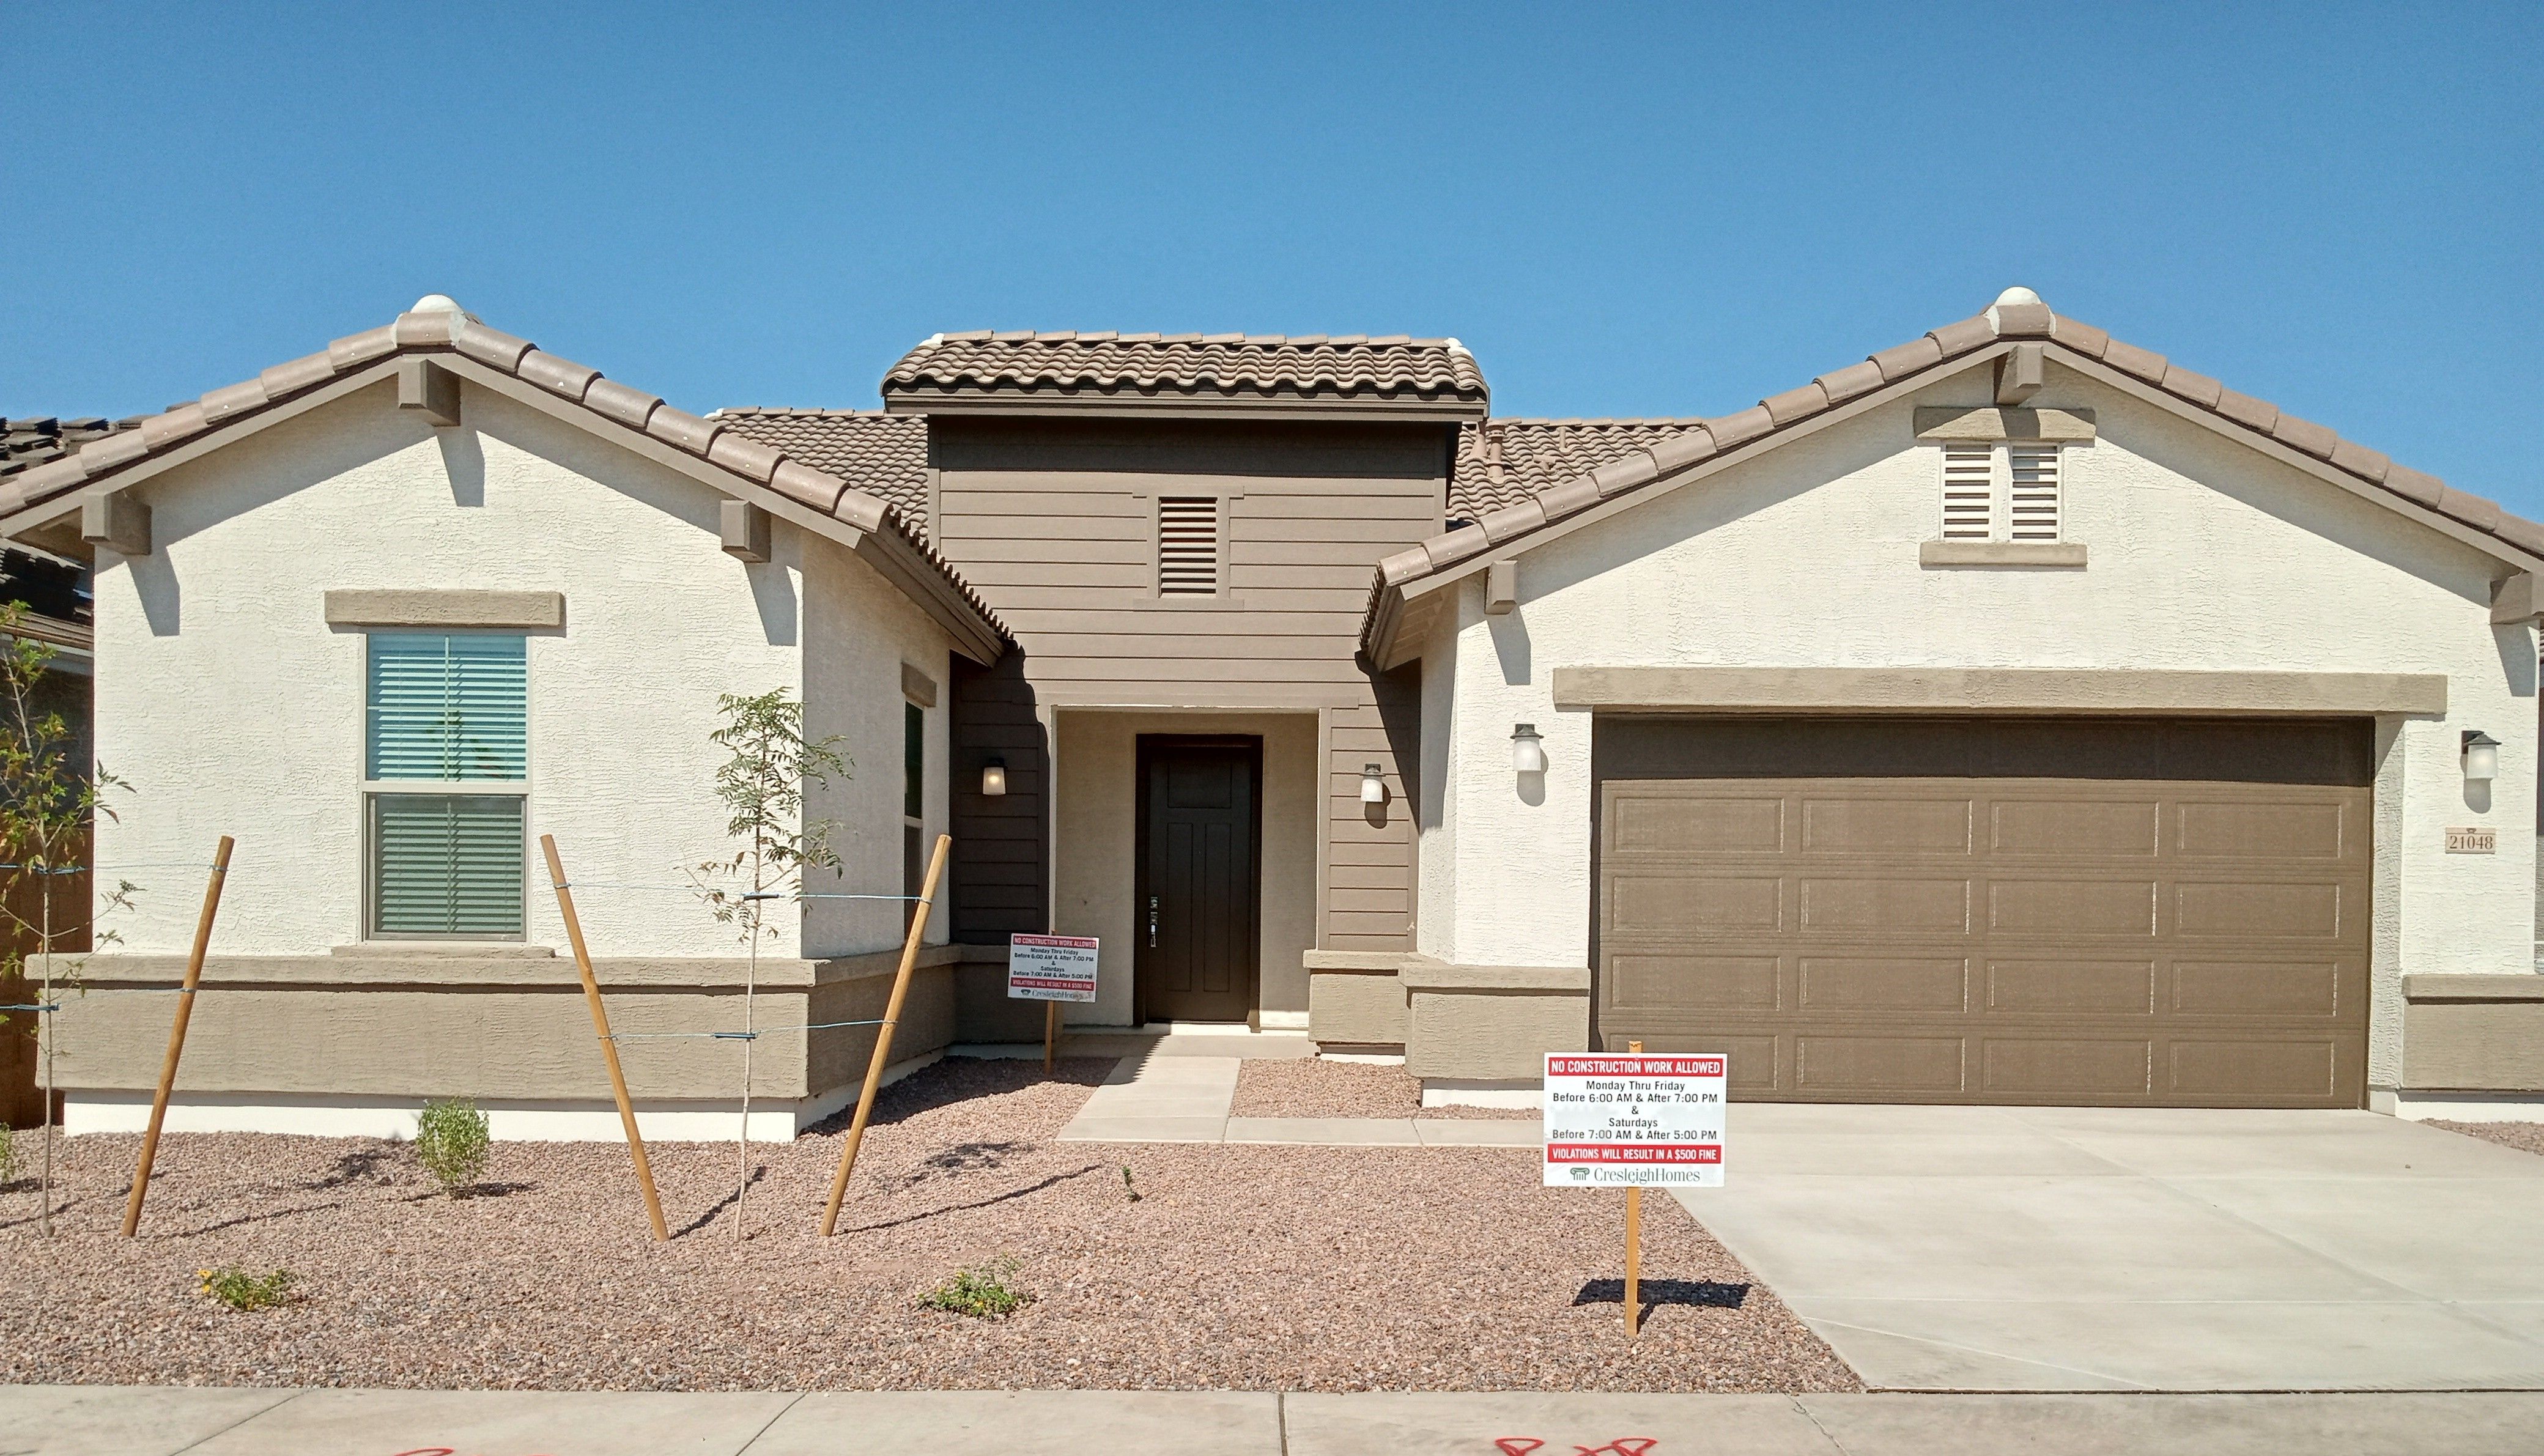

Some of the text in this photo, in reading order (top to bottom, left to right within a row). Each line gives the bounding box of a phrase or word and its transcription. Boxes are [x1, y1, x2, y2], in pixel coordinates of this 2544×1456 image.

[2450, 836, 2493, 849] 21048
[1551, 1060, 1720, 1074] NO CONSTRUCTION WORK ALLOWED
[1587, 1081, 1685, 1092] Monday Thru Friday
[1553, 1093, 1585, 1102] Before
[1702, 1094, 1718, 1103] PM
[1632, 1106, 1639, 1114] &
[1609, 1118, 1658, 1128] Saturdays
[1553, 1129, 1717, 1139] Before 7:00 AM & After 5:00 PM
[1552, 1148, 1716, 1161] VIOLATIONS WILL RESULT IN A $500 FINE
[1594, 1167, 1700, 1183] CresleighHomes
